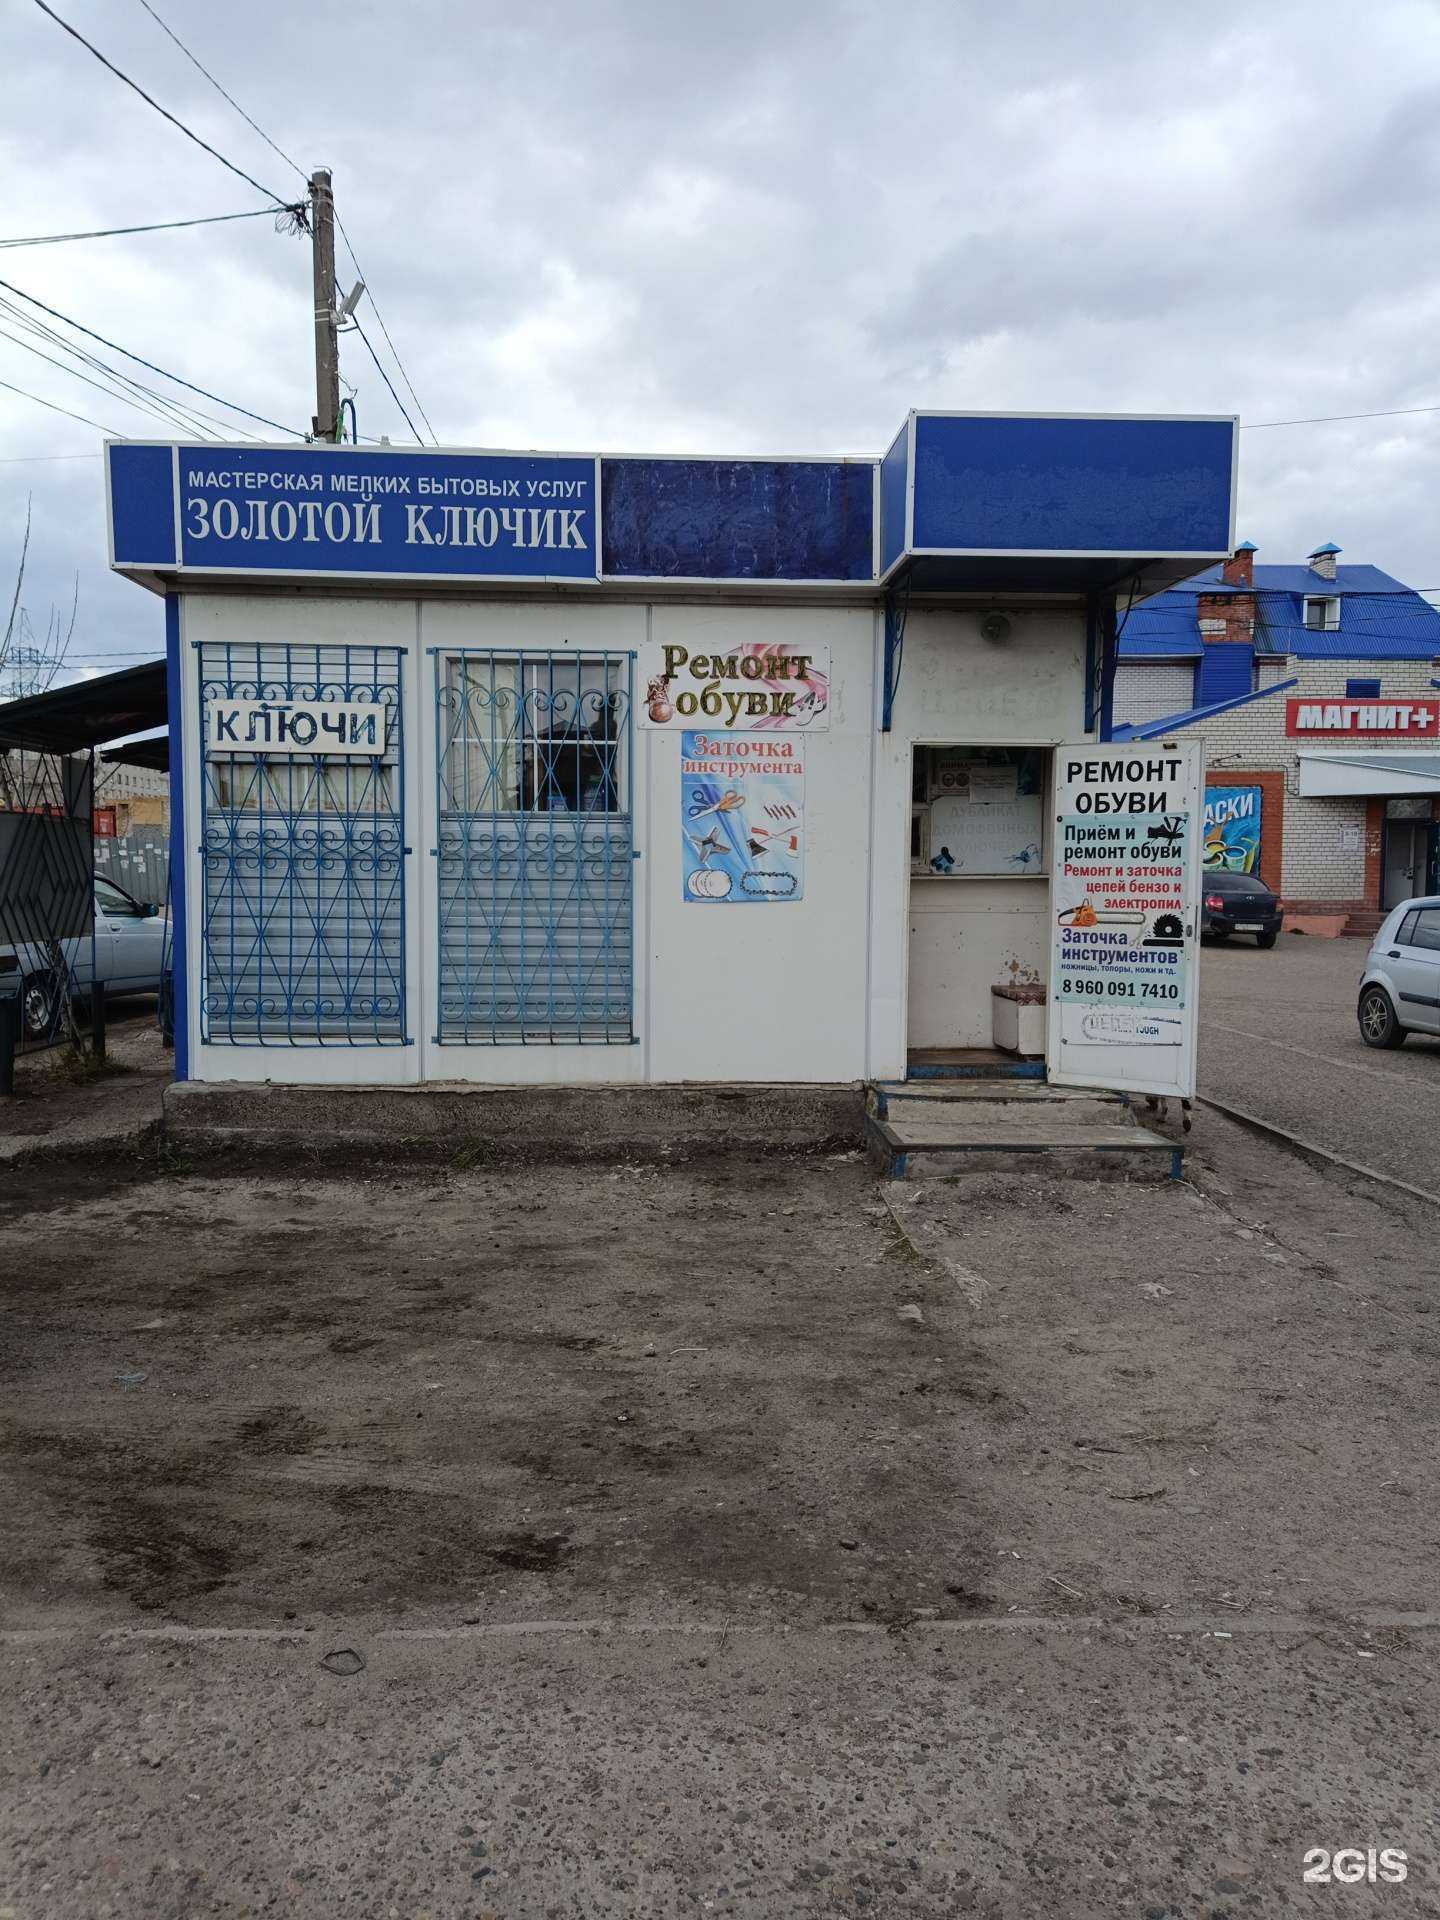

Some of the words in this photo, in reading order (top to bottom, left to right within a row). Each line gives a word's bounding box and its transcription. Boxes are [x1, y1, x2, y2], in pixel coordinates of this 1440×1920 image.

[188, 470, 324, 491] МАСТЕРСКАЯ
[330, 474, 411, 494] МЕЛКИХ
[418, 477, 521, 497] БЫТОВЫХ
[527, 480, 587, 498] УСЛУГ
[187, 493, 382, 543] ЗОЛОТОЙ
[405, 504, 588, 549] КЛЮЧИК
[661, 644, 813, 680] Ремонт
[675, 680, 797, 726] обуви
[217, 710, 376, 745] КЛЮЧИ
[1296, 704, 1434, 729] МАГНИТ+
[693, 735, 794, 757] Заточка
[683, 759, 803, 777] инструмента
[1067, 759, 1182, 783] РЕМОНТ
[1075, 792, 1167, 814] ОБУВИ
[1203, 792, 1254, 826] АСКИ
[1065, 825, 1120, 844] Приём
[1125, 827, 1135, 840] и
[1064, 846, 1126, 862] ремонт
[1130, 842, 1182, 862] обуви
[1064, 864, 1112, 876] Ремонт
[1115, 866, 1123, 876] и
[1127, 866, 1182, 877] заточка
[1086, 880, 1126, 896] цепей
[1129, 880, 1170, 893] бензо
[1174, 883, 1181, 893] и
[1104, 898, 1181, 912] электропил
[1062, 928, 1128, 945] Заточка
[1061, 948, 1178, 965] инструментов
[1062, 979, 1071, 993] 8
[1075, 980, 1104, 995] 960
[1108, 982, 1136, 997] 091
[1141, 983, 1179, 999] 7410
